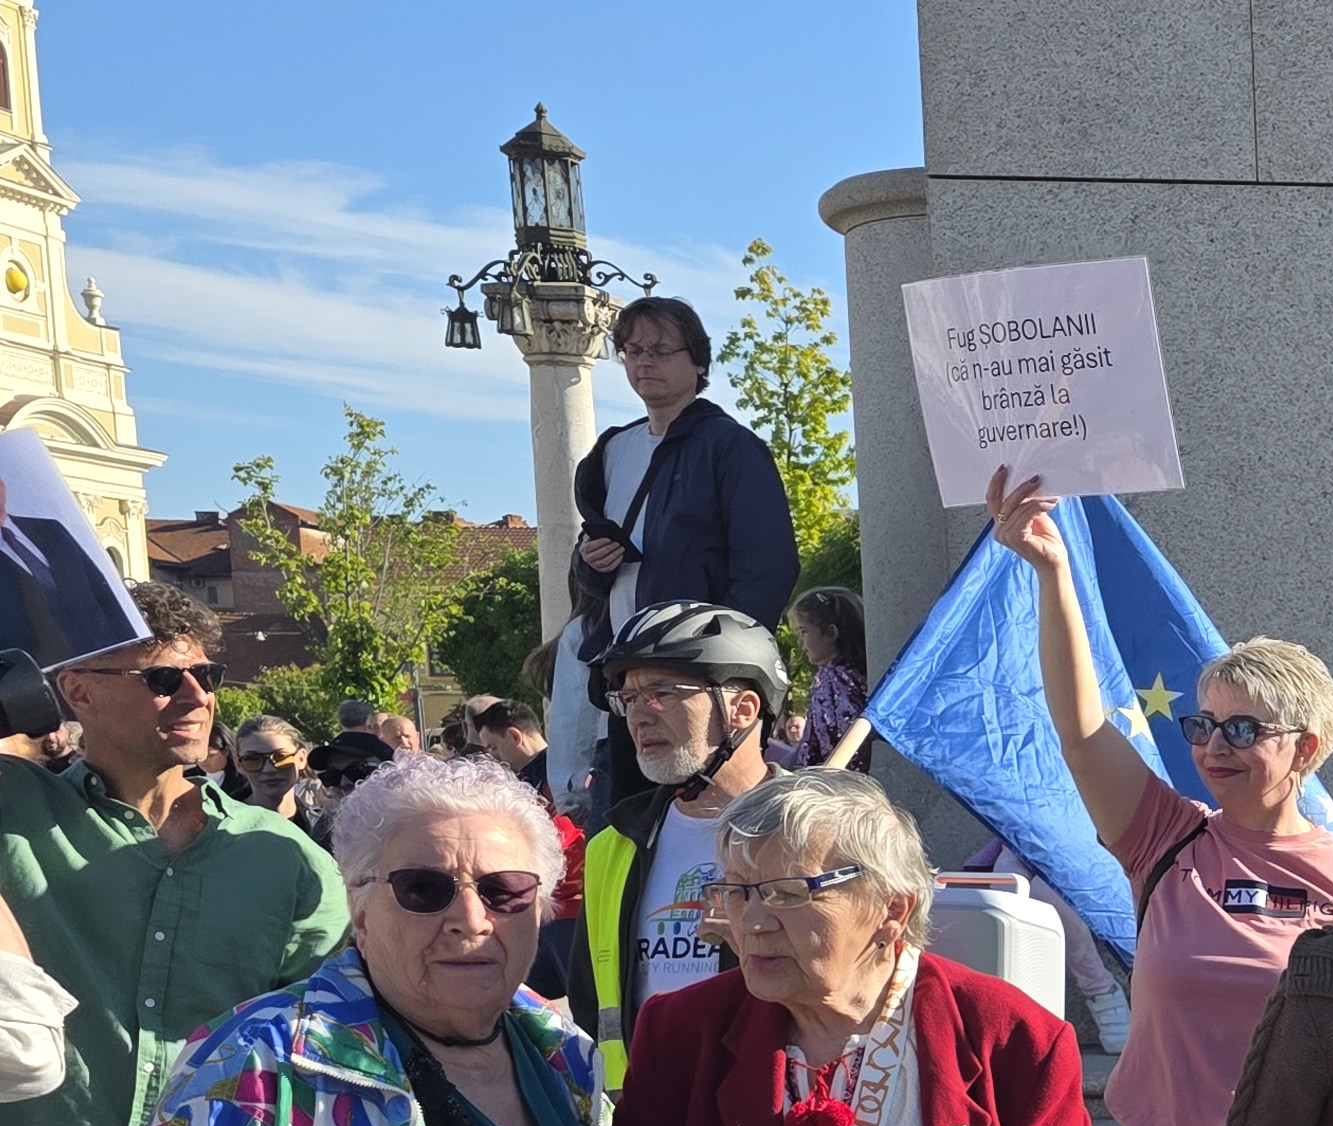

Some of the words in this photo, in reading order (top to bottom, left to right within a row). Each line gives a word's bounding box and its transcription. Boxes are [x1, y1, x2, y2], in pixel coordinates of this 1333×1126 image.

[947, 327, 976, 351] Fug
[979, 313, 1096, 349] ȘOBOLANII
[946, 358, 969, 387] (că
[973, 358, 1012, 380] n-au
[1018, 350, 1055, 374] mai
[1061, 346, 1113, 375] găsit
[982, 384, 1045, 411] brânză
[1051, 384, 1070, 404] la
[978, 415, 1087, 448] guvernare!)
[637, 937, 720, 960] RADEA
